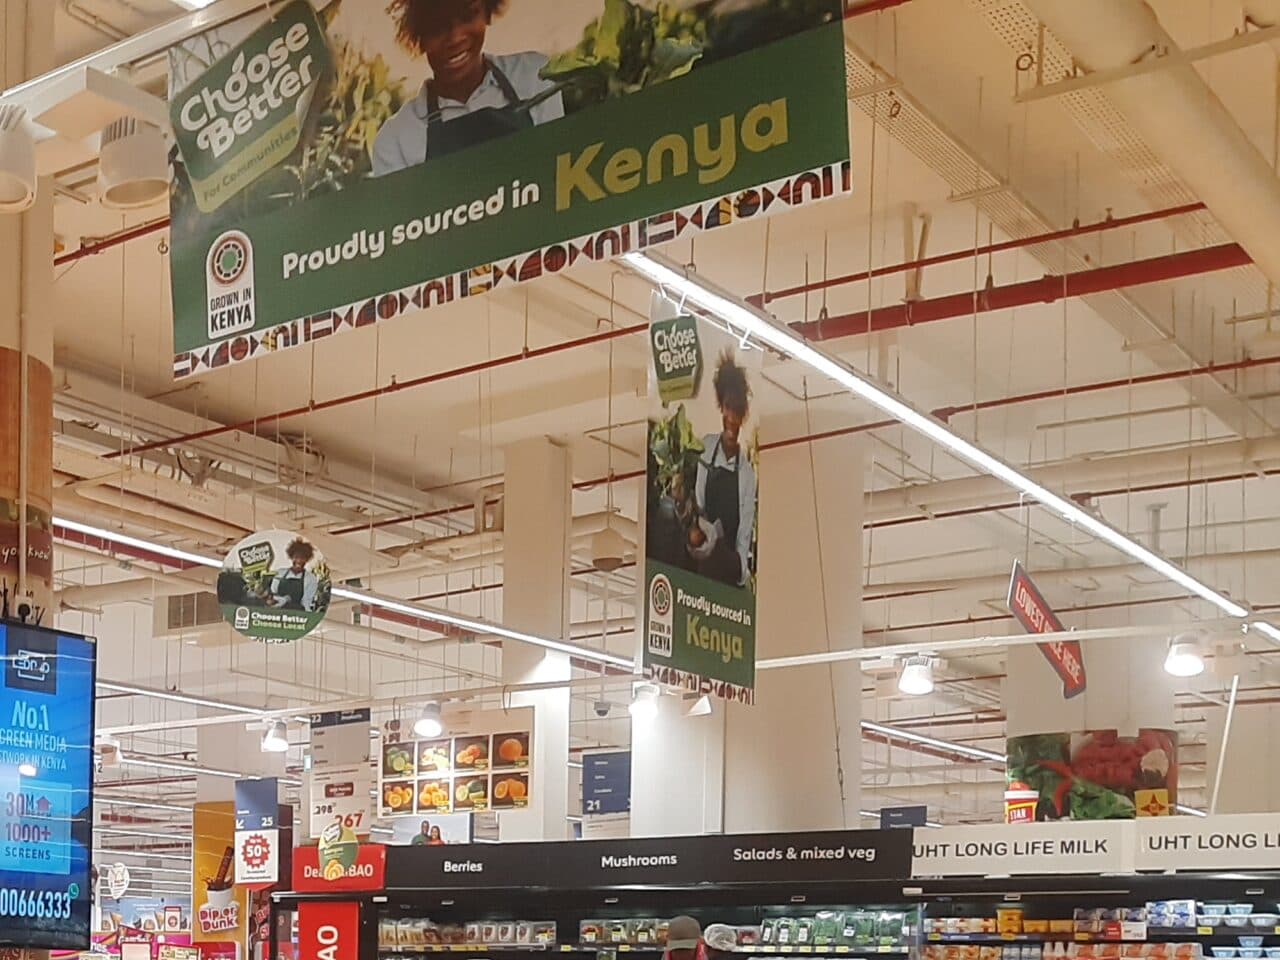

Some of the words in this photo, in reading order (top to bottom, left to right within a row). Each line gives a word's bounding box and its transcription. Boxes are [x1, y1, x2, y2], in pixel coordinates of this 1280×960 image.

[180, 22, 309, 131] Choose
[196, 55, 313, 158] Better
[203, 184, 221, 201] For
[222, 126, 299, 186] Communities
[282, 225, 385, 279] Proudly
[391, 186, 505, 247] sourced
[512, 180, 540, 208] in
[555, 97, 789, 212] Kenya
[210, 291, 239, 311] GROWN
[242, 287, 252, 302] IN
[210, 304, 252, 333] KENYA
[654, 323, 696, 353] Choose
[659, 346, 697, 373] Better
[2, 546, 19, 564] yo
[251, 612, 281, 621] Choose
[677, 588, 711, 617] Proudly
[711, 603, 743, 623] sourced
[743, 609, 752, 626] in
[686, 613, 743, 663] Kenya
[11, 700, 49, 731] No.1
[34, 733, 67, 753] MEDIA
[41, 756, 67, 770] KENYA
[586, 800, 600, 811] 21
[261, 816, 273, 827] 25
[5, 822, 52, 844] 1000+
[1148, 835, 1192, 851] UHT
[1197, 833, 1258, 850] LONG
[1264, 833, 1280, 848] LI
[4, 847, 51, 861] SCREENS
[733, 847, 783, 861] Salads
[786, 847, 797, 860] &
[800, 845, 844, 860] mixed
[847, 848, 876, 862] veg
[913, 843, 951, 859] UHT
[955, 842, 1008, 857] LONG
[1014, 840, 1054, 856] LIFE
[1060, 839, 1108, 854] MILK
[443, 860, 483, 873] Berries
[601, 853, 678, 869] Mushrooms
[200, 908, 219, 921] Dip
[222, 906, 236, 917] or
[202, 917, 236, 931] Dunk
